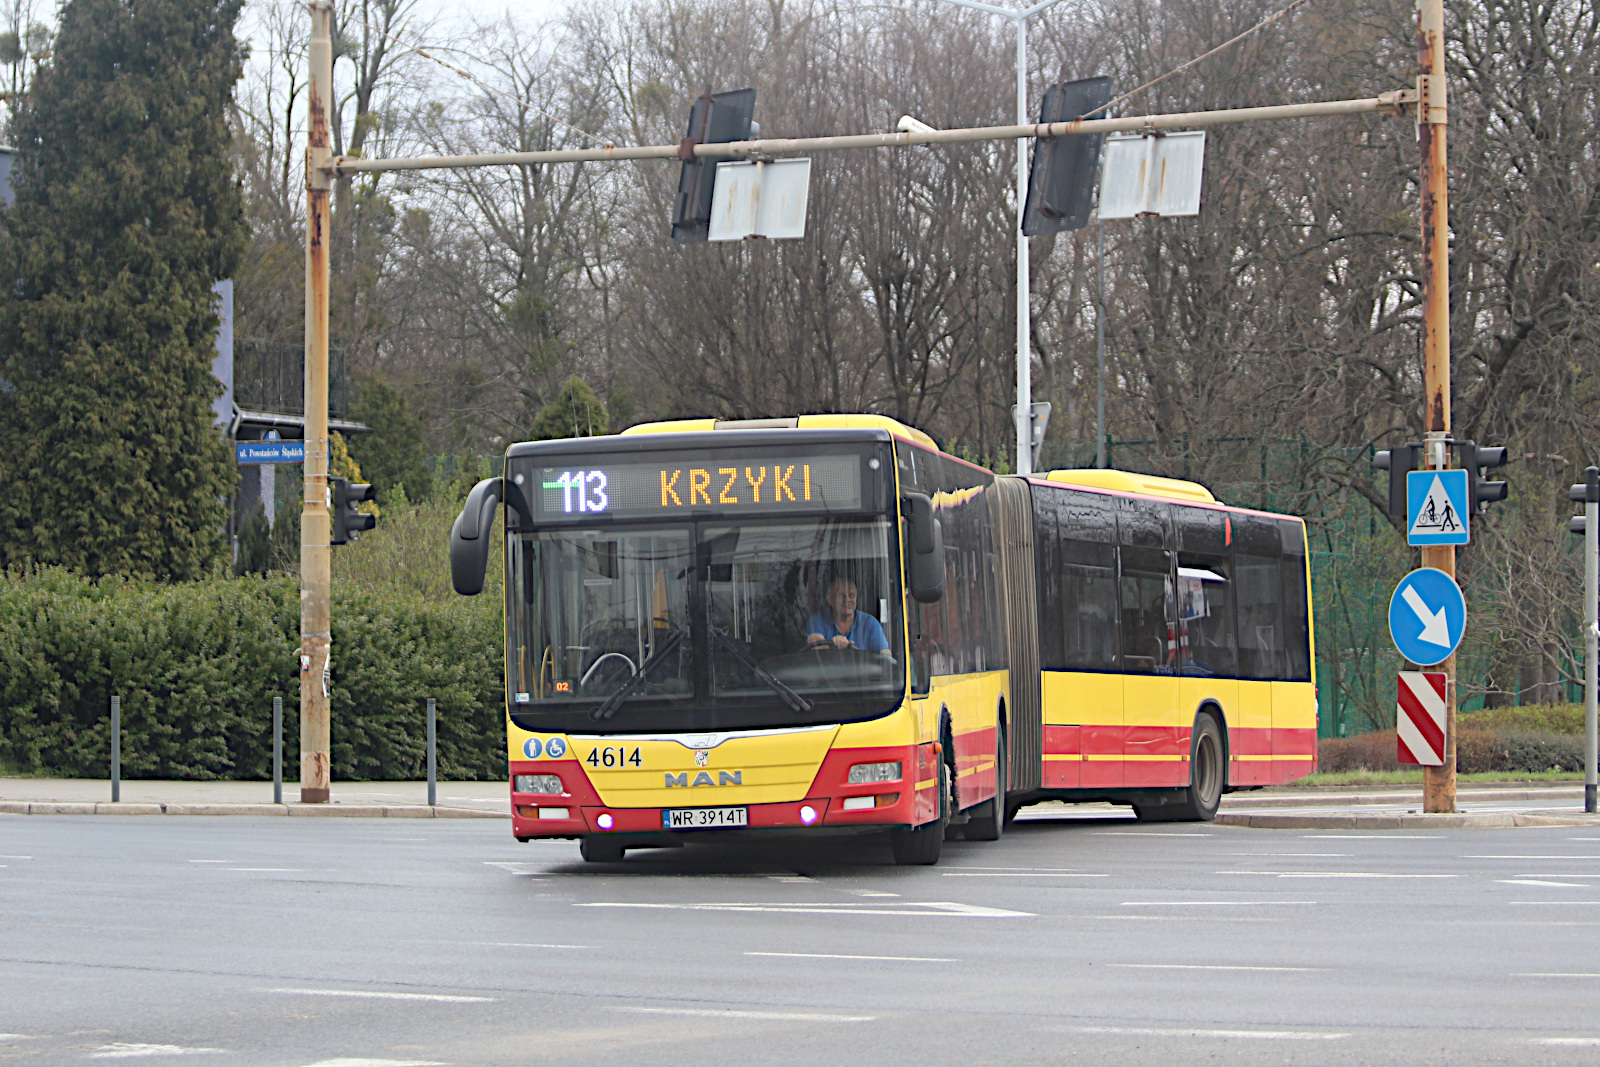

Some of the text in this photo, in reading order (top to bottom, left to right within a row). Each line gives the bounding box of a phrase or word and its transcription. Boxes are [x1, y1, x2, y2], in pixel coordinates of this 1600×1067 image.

[249, 448, 279, 457] Powstańców
[282, 445, 303, 458] Śląskich
[556, 464, 811, 512] 113 KRZYKI
[556, 681, 569, 691] 02
[586, 746, 642, 768] 4614
[664, 769, 743, 788] MAN
[672, 809, 744, 826] WR 3914T
